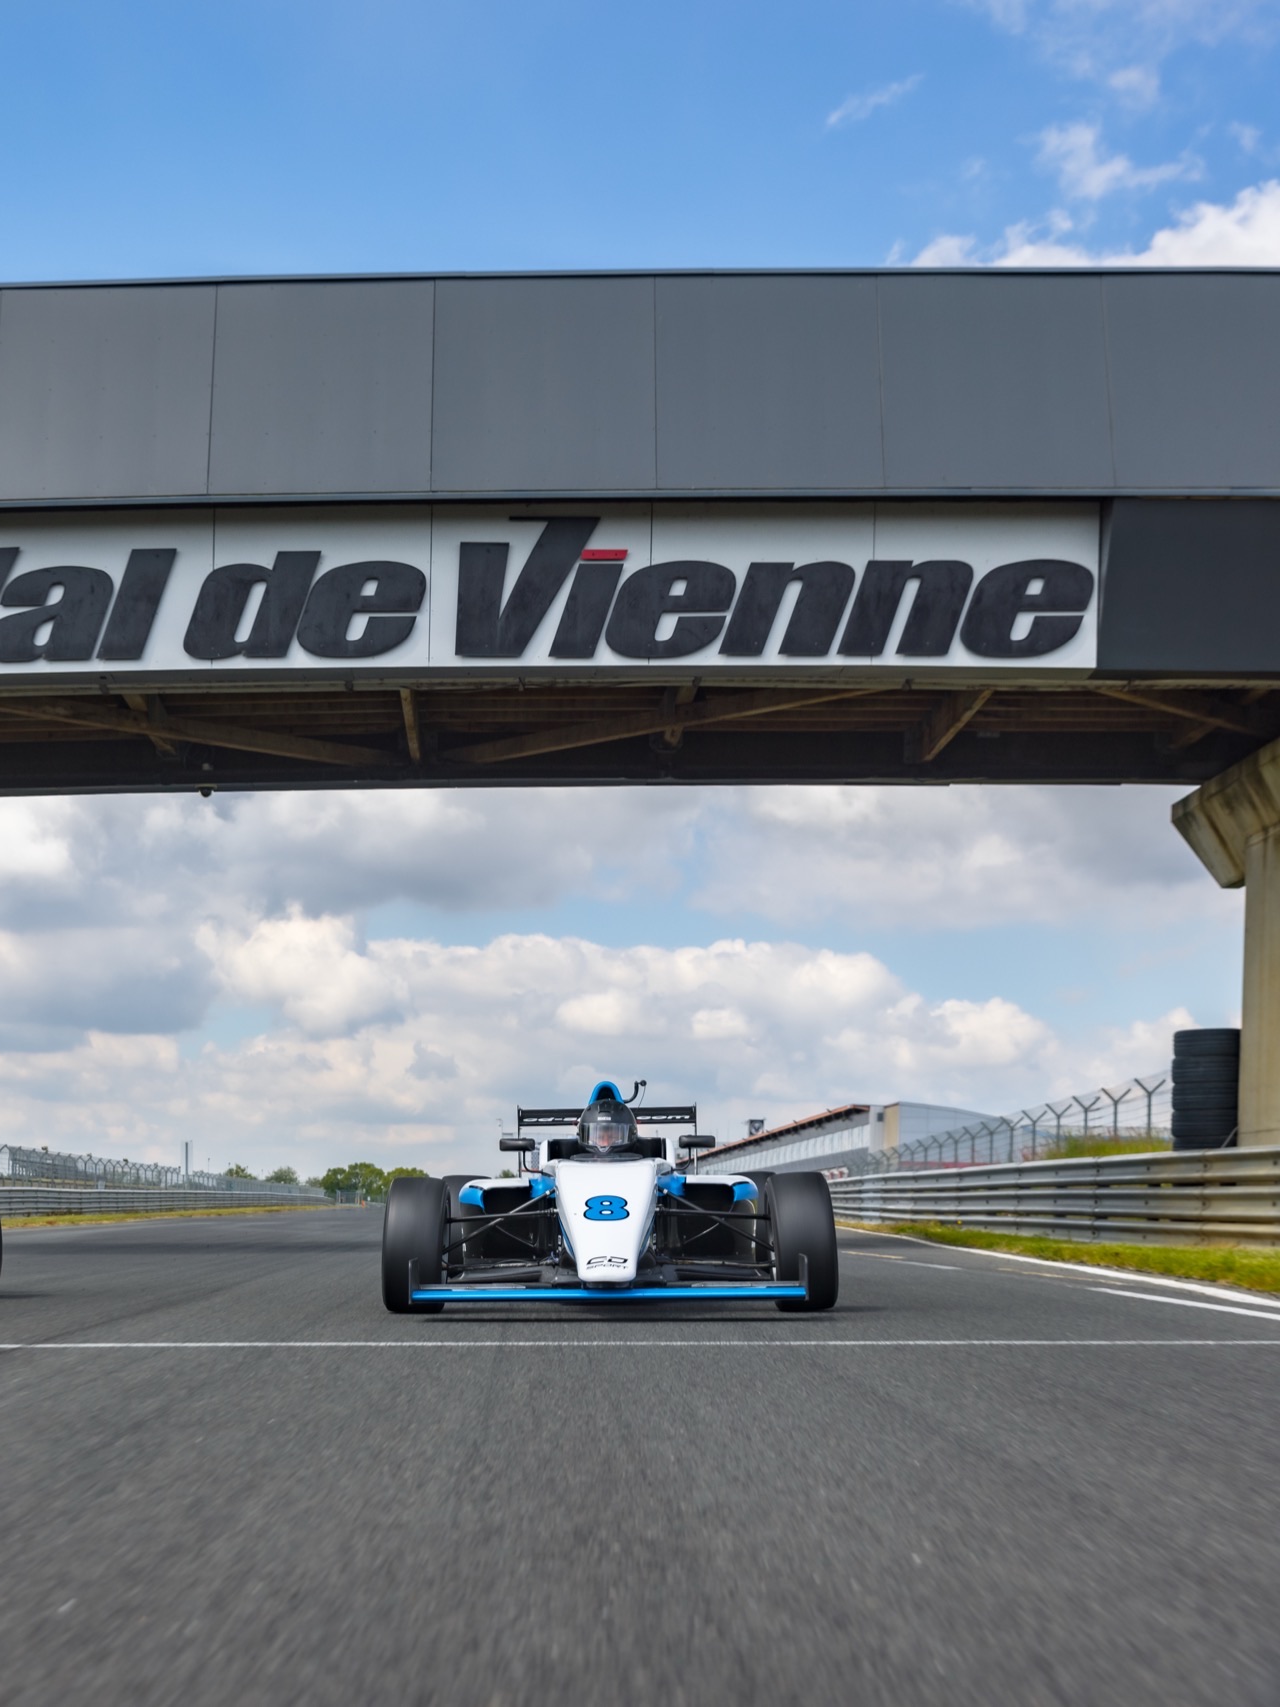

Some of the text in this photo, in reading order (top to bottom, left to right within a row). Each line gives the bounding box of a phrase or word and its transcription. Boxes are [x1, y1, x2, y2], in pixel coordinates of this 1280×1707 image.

[182, 550, 428, 660] de
[454, 515, 1096, 659] Vienne
[583, 1195, 630, 1221] 8
